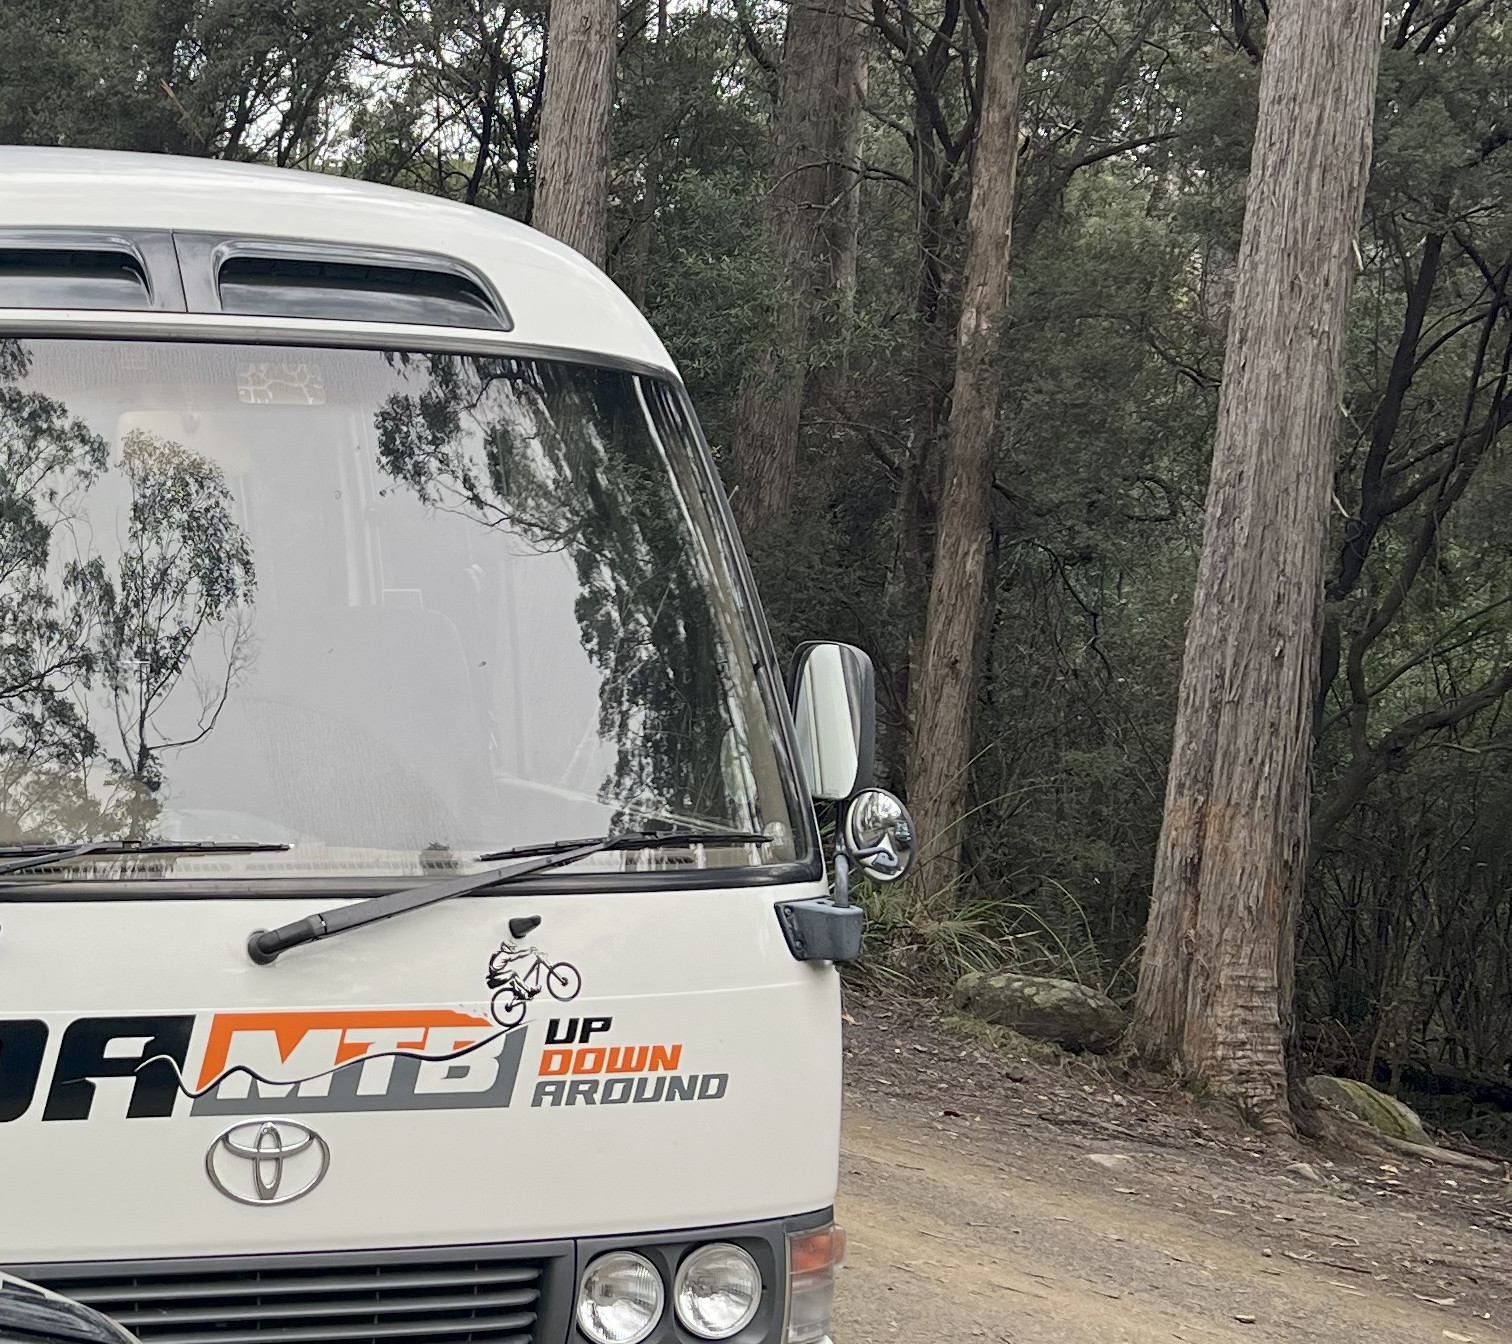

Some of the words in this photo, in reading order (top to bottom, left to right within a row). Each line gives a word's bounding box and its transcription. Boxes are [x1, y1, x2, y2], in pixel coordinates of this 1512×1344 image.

[544, 1016, 613, 1045] UP
[538, 1044, 683, 1077] DOWN
[530, 1073, 729, 1108] AROUND
